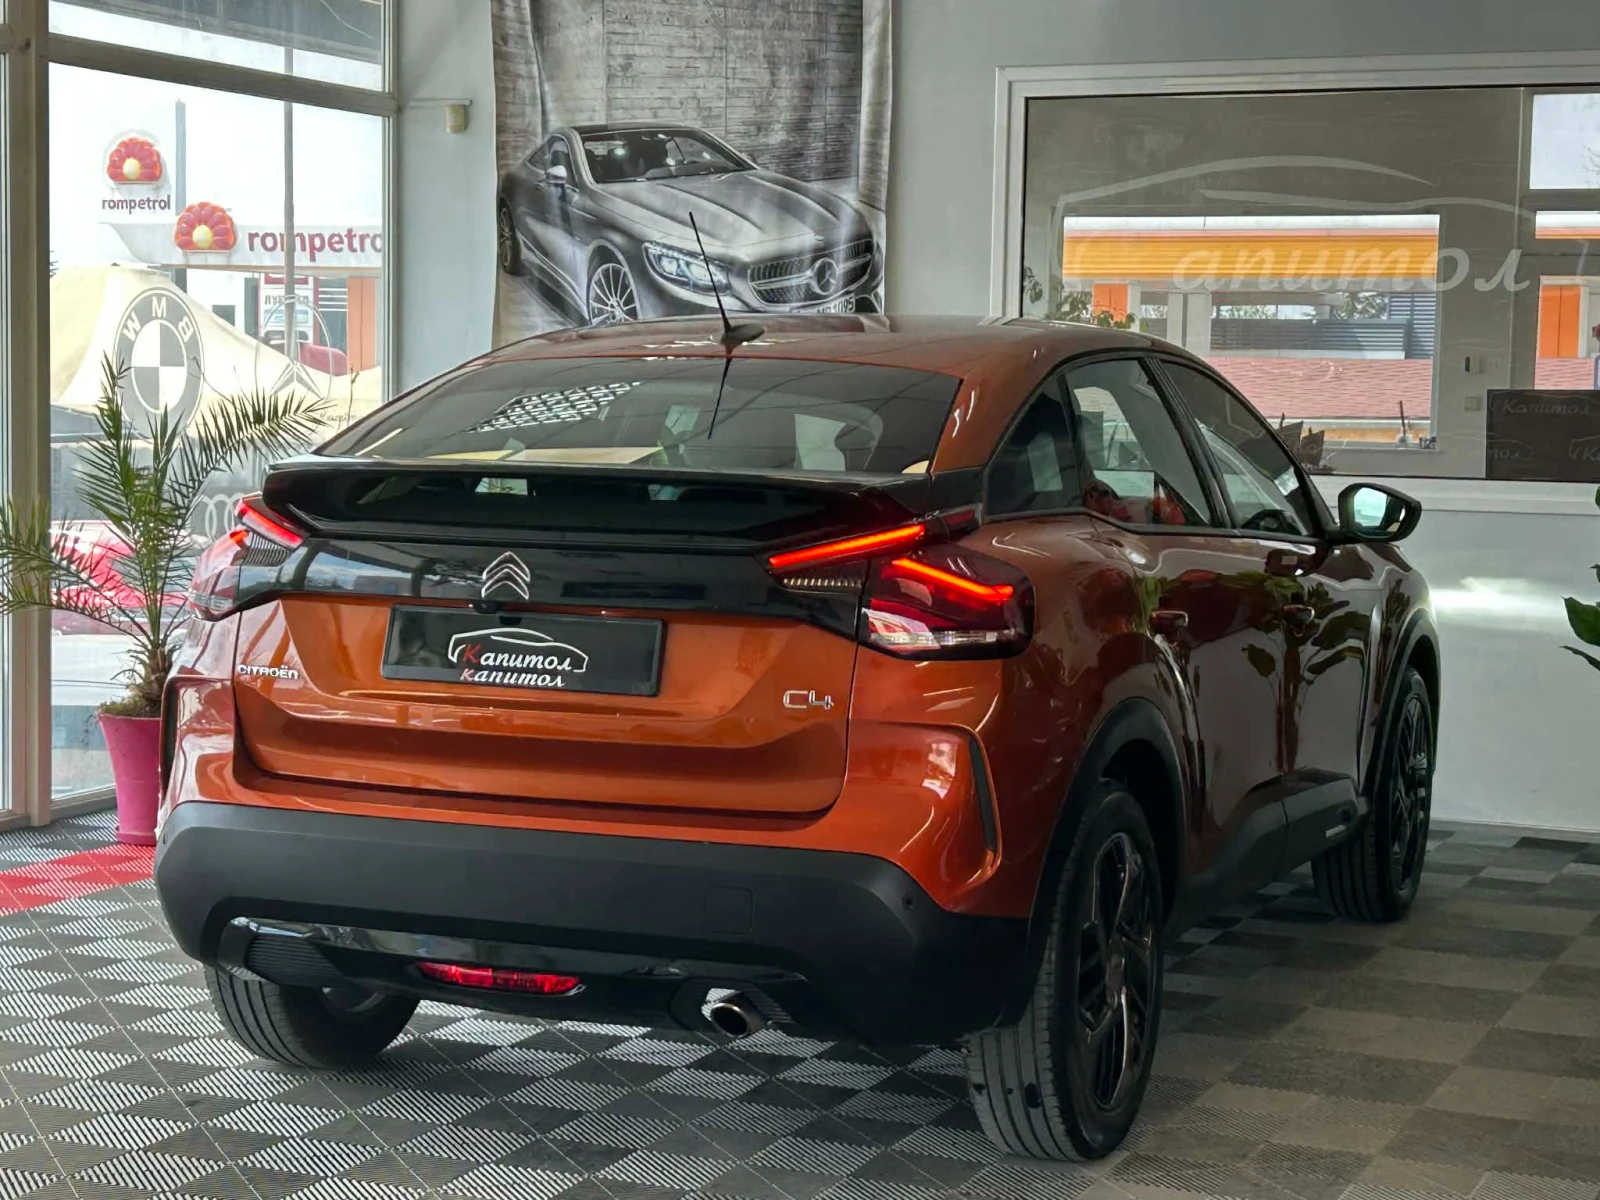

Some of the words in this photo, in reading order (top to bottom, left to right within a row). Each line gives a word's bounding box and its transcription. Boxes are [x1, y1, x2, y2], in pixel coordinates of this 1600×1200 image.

[102, 195, 171, 214] rompetrol
[1173, 246, 1530, 292] апитол
[782, 689, 835, 710] C4
